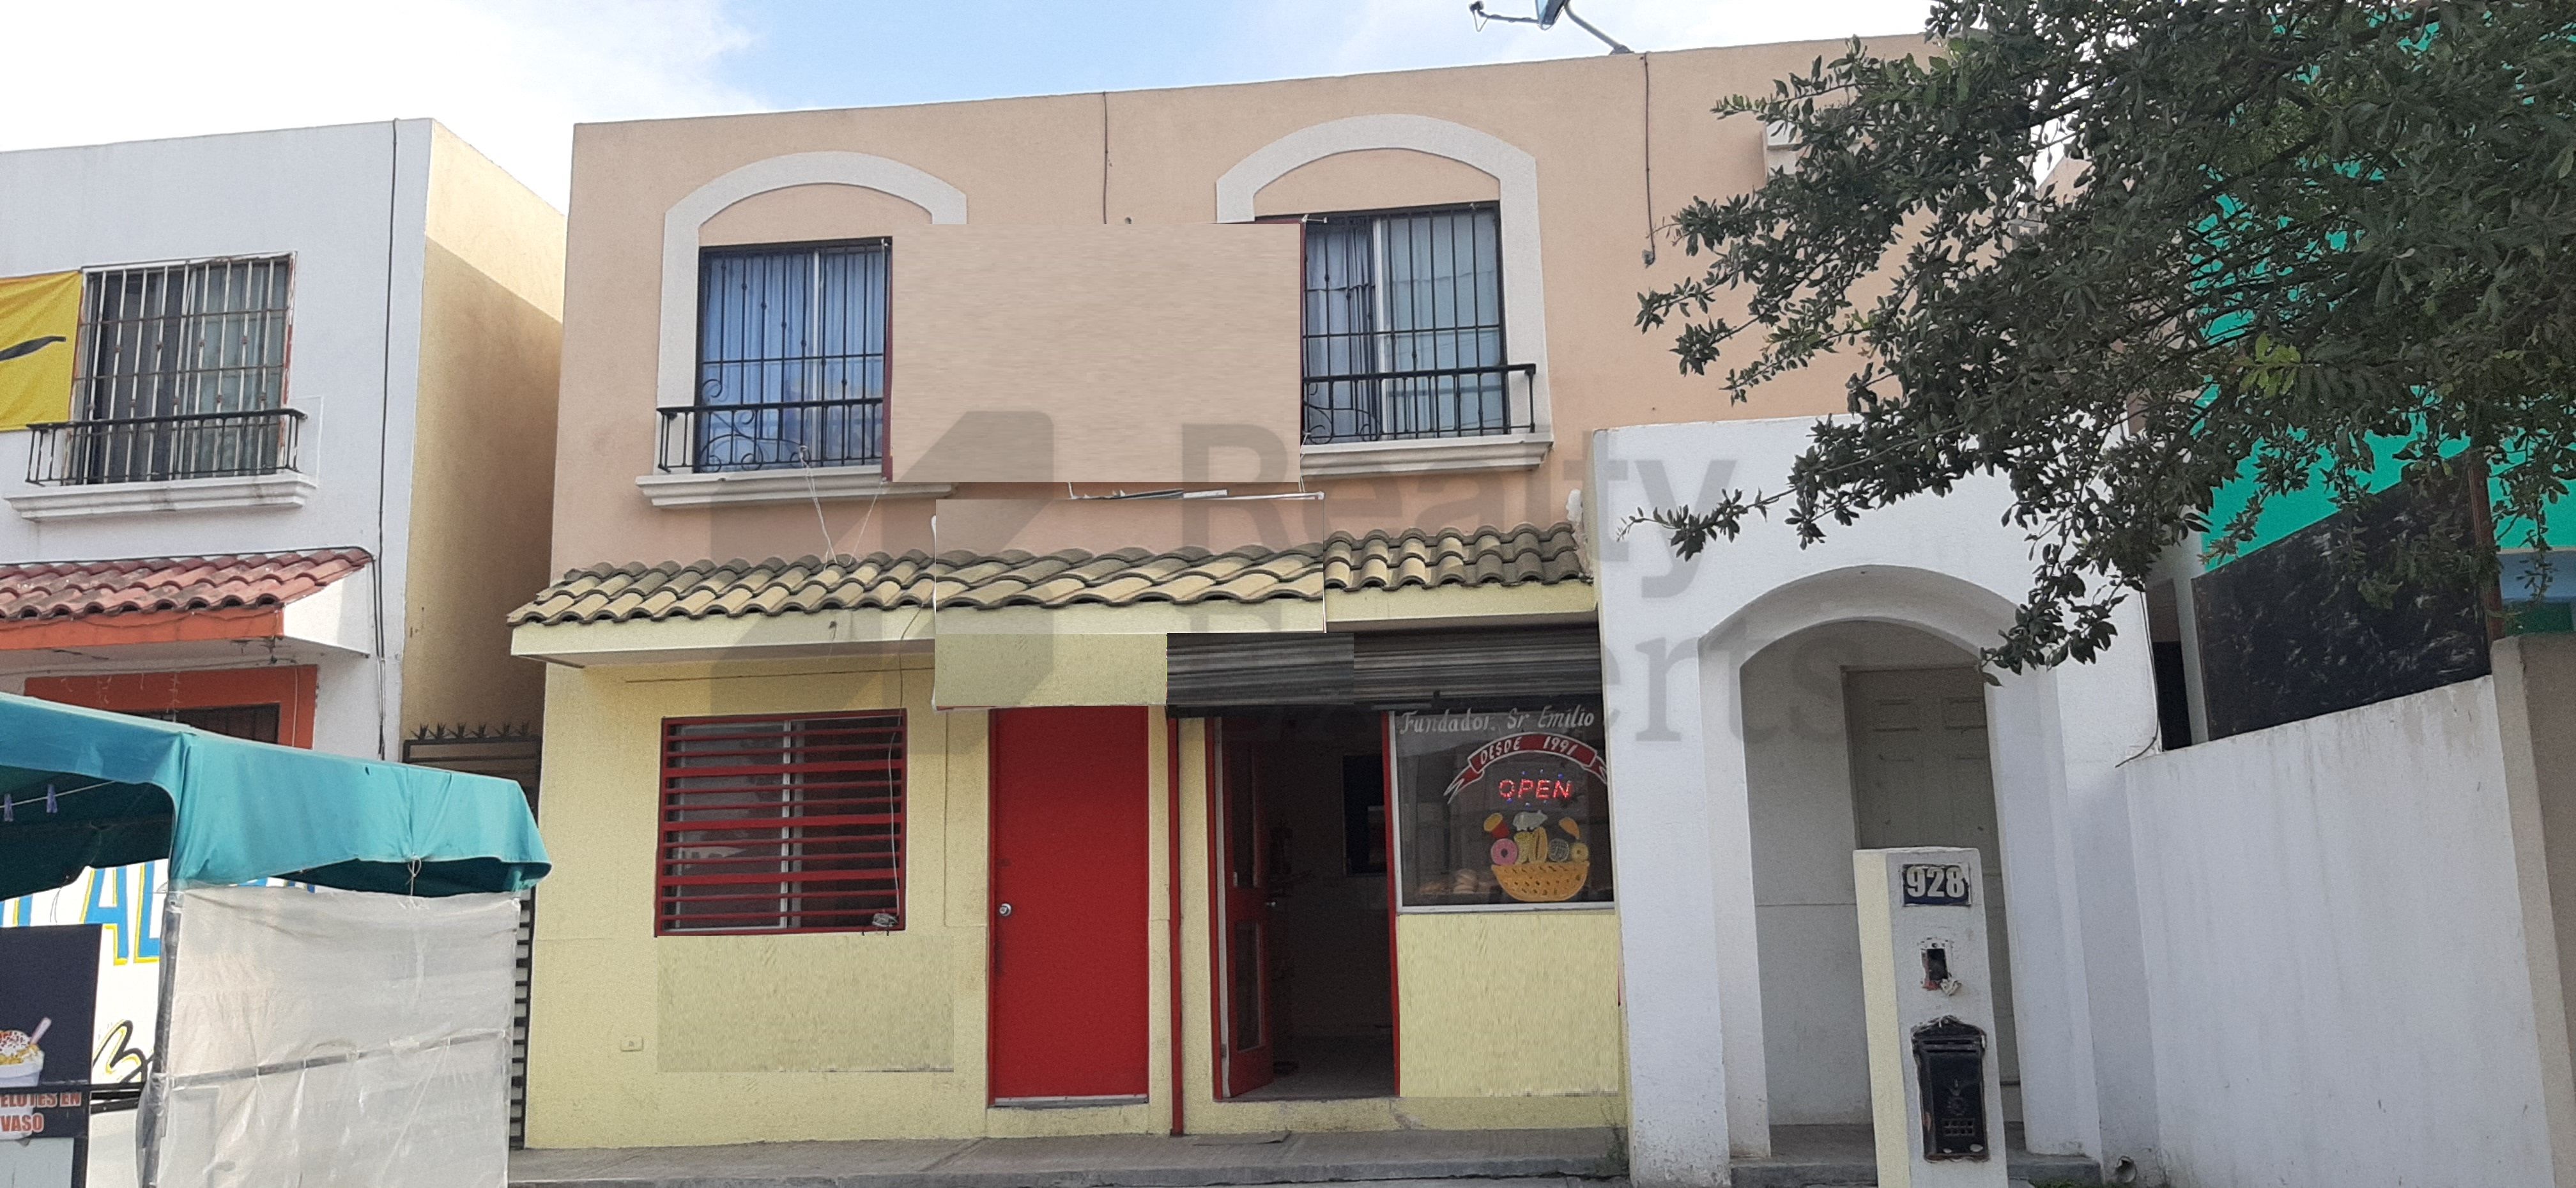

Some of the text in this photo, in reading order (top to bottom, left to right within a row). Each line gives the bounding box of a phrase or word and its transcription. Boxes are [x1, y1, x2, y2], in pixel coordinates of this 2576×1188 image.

[1507, 707, 1530, 729] Sr
[1538, 704, 1595, 728] Emilio
[1480, 735, 1578, 765] DESDE 1991
[1498, 779, 1573, 799] OPEN
[1906, 865, 1965, 898] 928
[59, 1092, 82, 1107] EN
[0, 1112, 44, 1133] VASO
